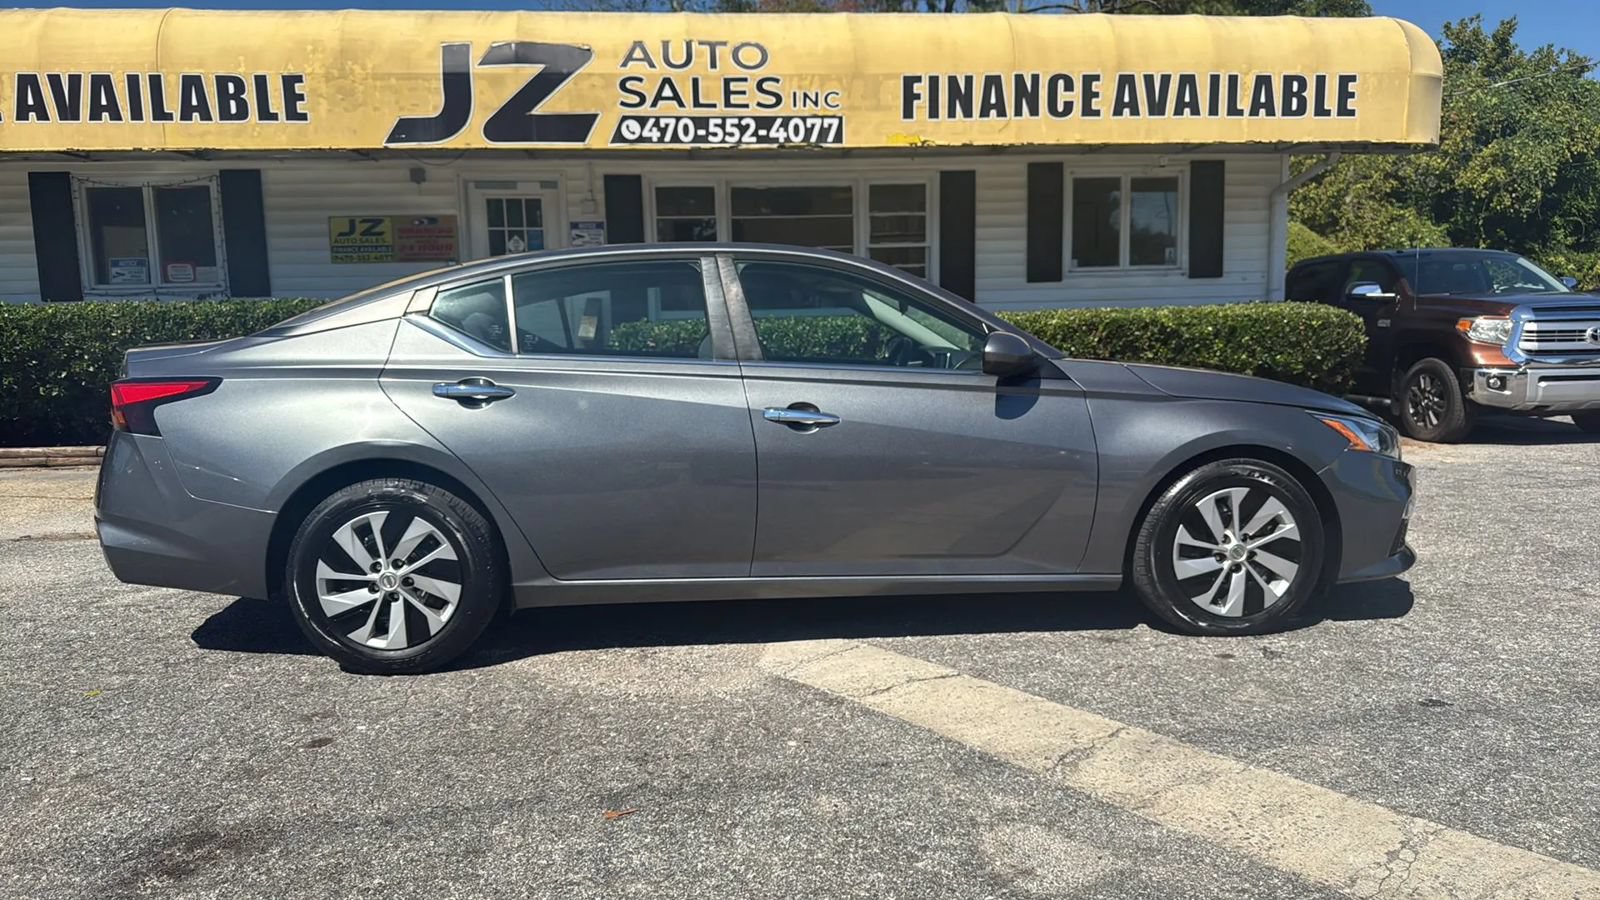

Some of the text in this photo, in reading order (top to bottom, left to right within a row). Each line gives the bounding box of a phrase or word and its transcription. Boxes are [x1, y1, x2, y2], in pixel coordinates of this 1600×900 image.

[620, 39, 769, 70] AUTO
[14, 73, 309, 122] AVAILABLE
[384, 41, 600, 145] JZ
[619, 76, 840, 109] SALES INC
[901, 73, 1358, 120] FINANCE AVAILABLE
[642, 117, 840, 143] 470-552-4077
[337, 218, 385, 237] JZ
